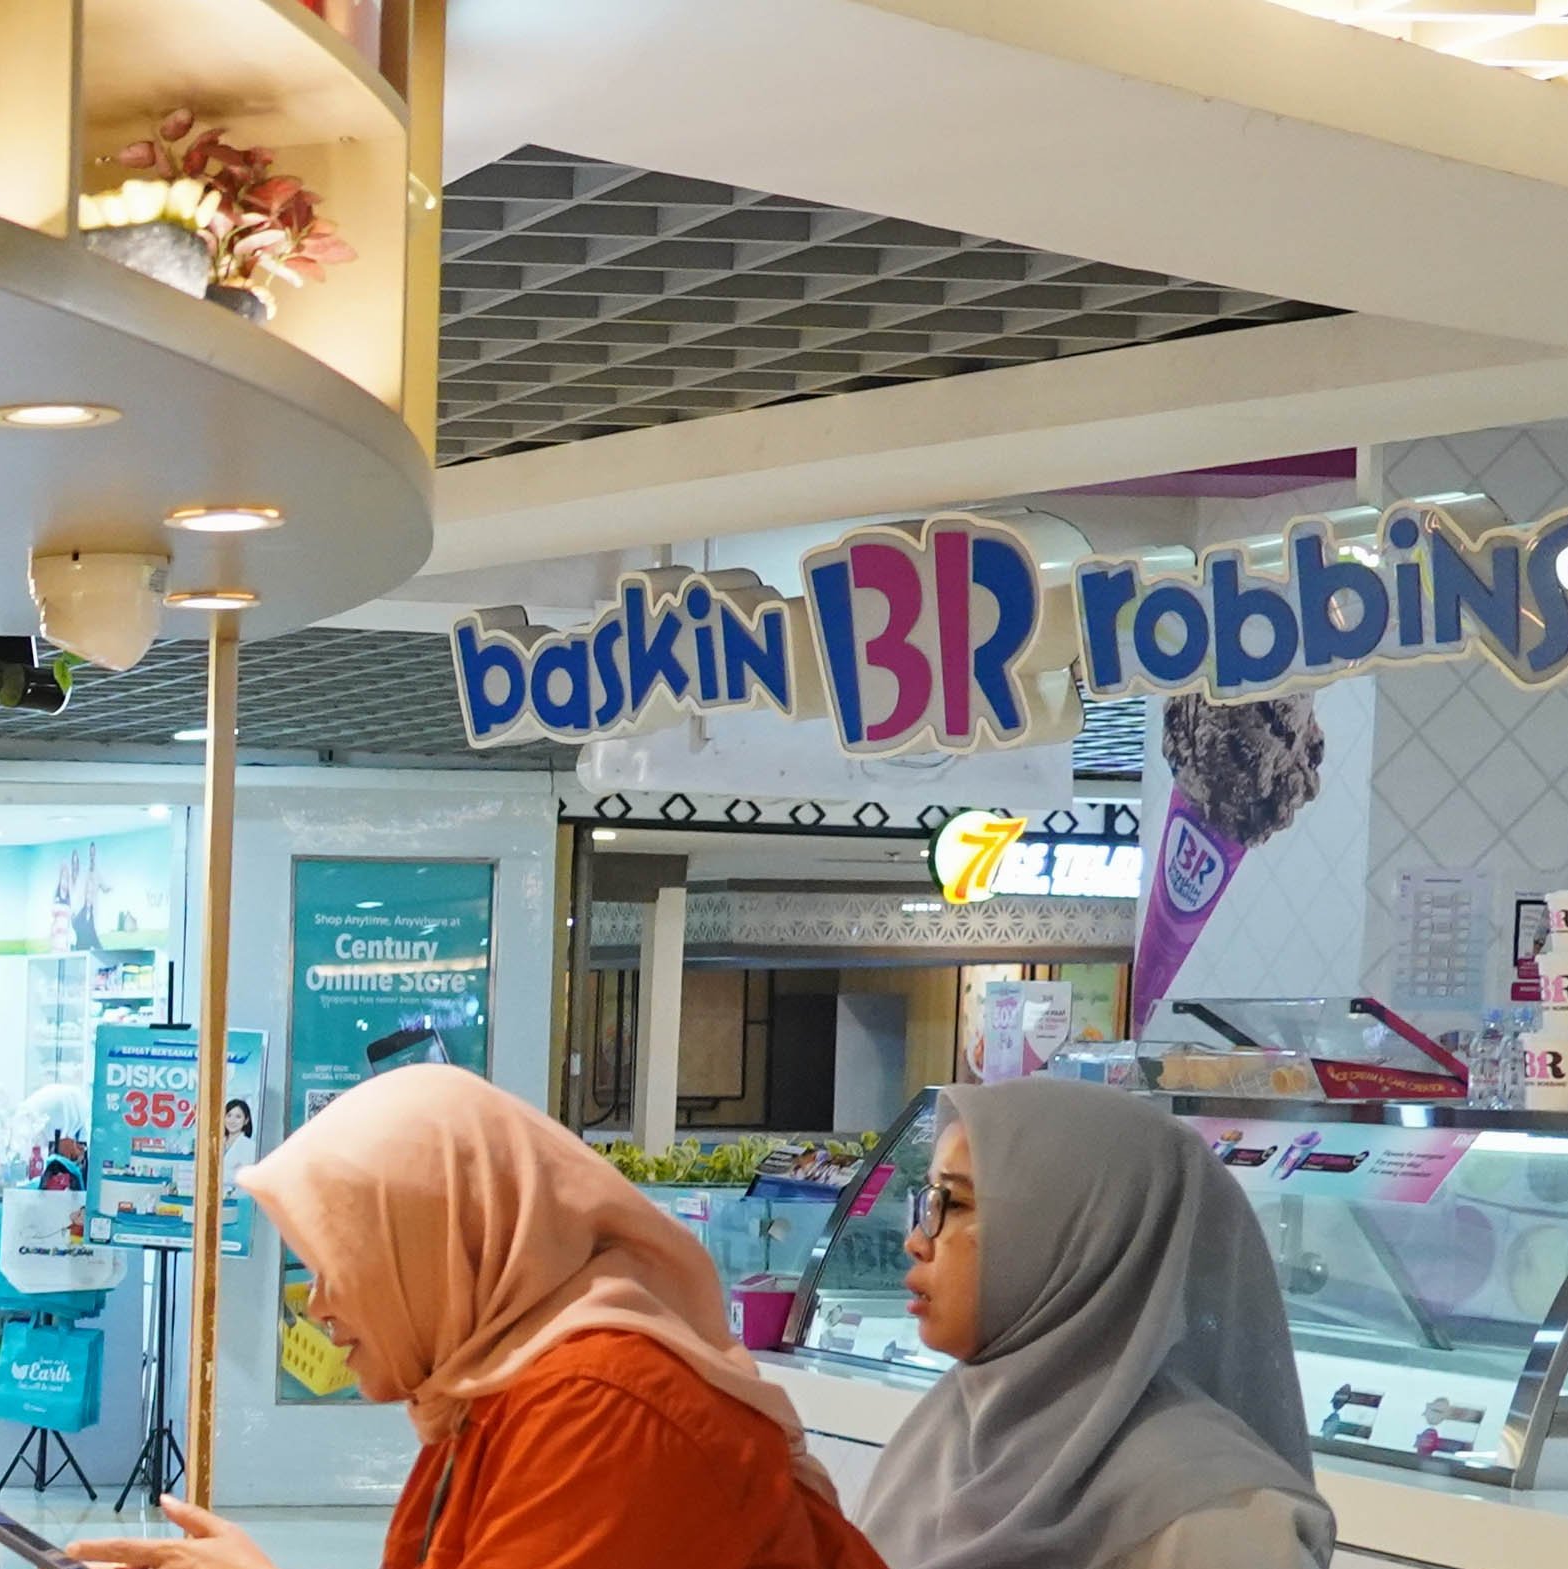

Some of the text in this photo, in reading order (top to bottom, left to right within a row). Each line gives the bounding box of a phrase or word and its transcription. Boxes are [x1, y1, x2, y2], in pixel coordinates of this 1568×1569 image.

[811, 531, 1034, 744] BR
[315, 914, 342, 926] Shop
[394, 916, 448, 928] Anywhere
[449, 917, 461, 927] at
[335, 933, 439, 962] Century
[399, 966, 466, 993] Store
[29, 1362, 71, 1383] Earth
